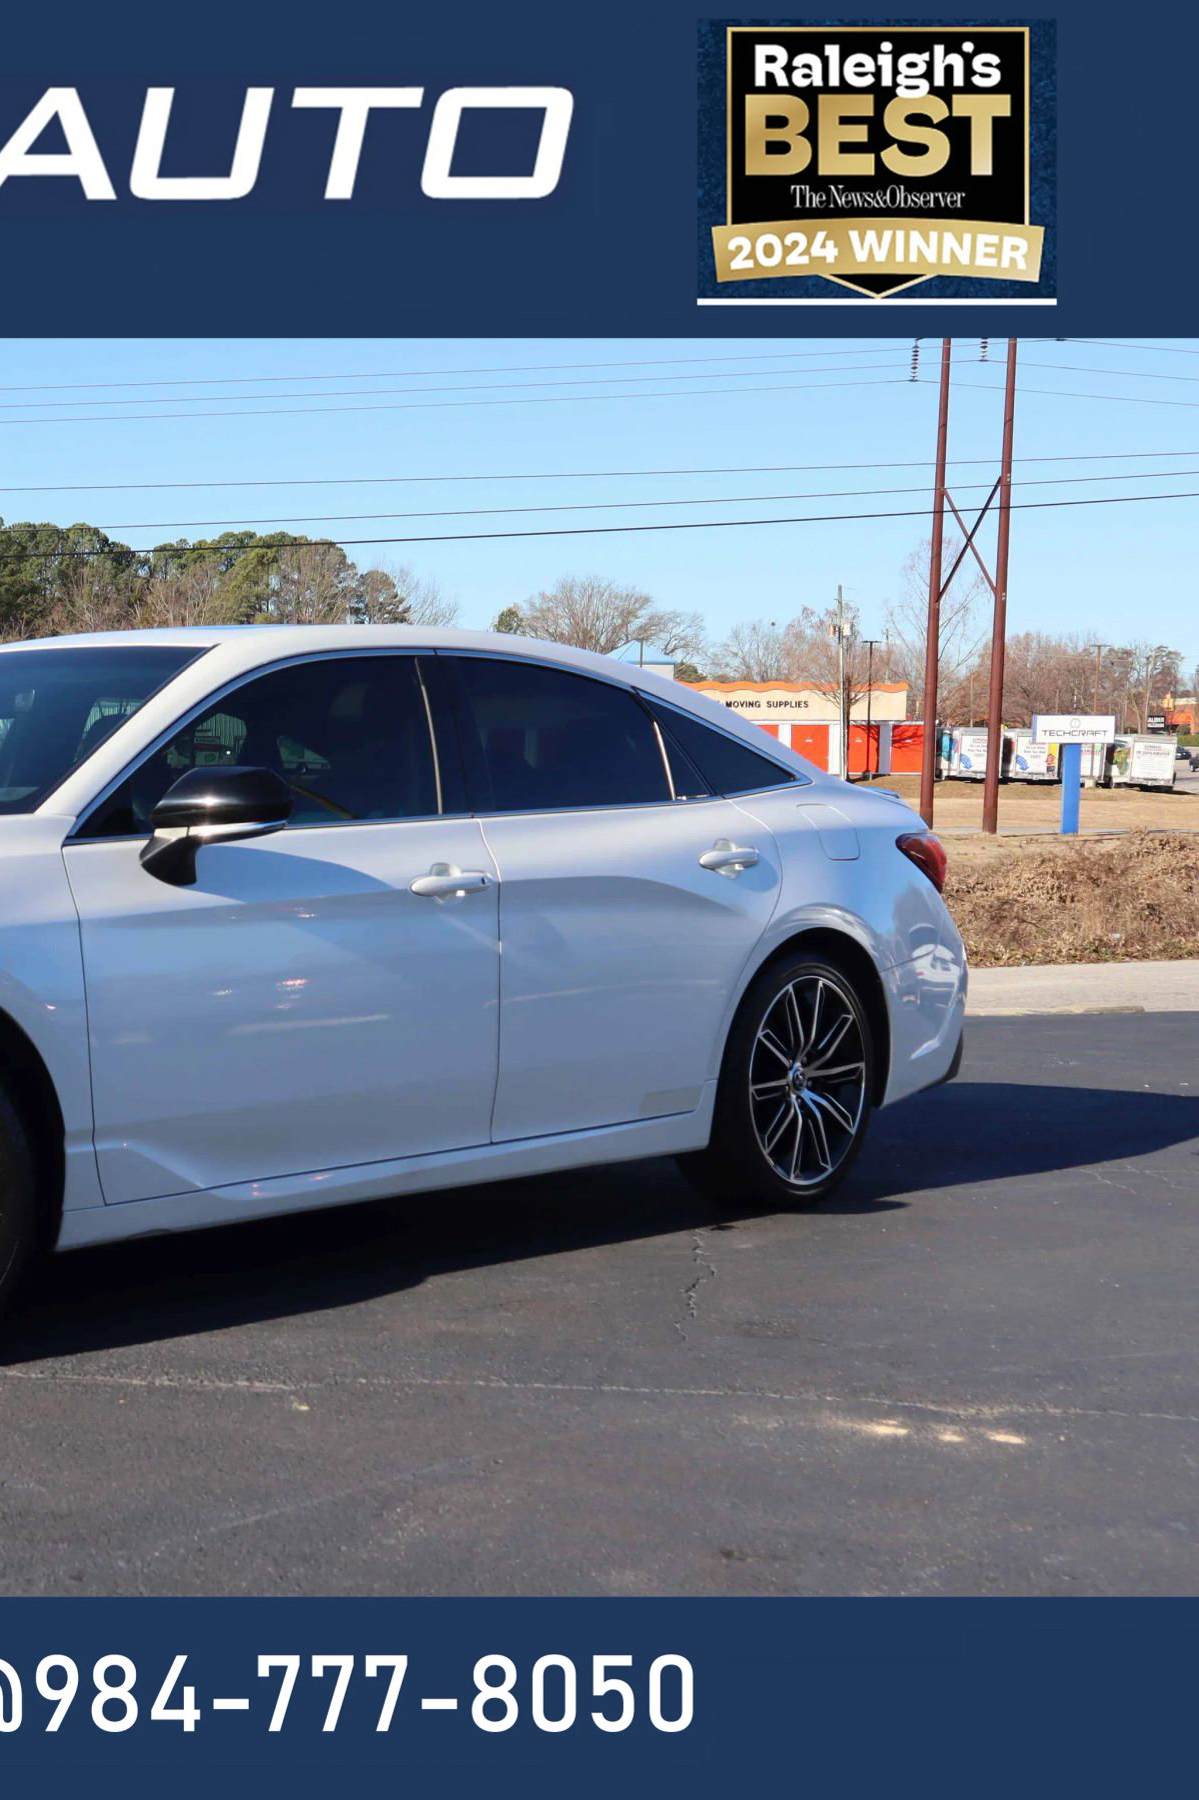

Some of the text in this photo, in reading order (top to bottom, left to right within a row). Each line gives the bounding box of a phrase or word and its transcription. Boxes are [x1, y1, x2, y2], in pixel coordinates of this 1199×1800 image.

[725, 700, 809, 709] MOVING SUPPLIES
[1041, 729, 1109, 737] TECHCRAFT
